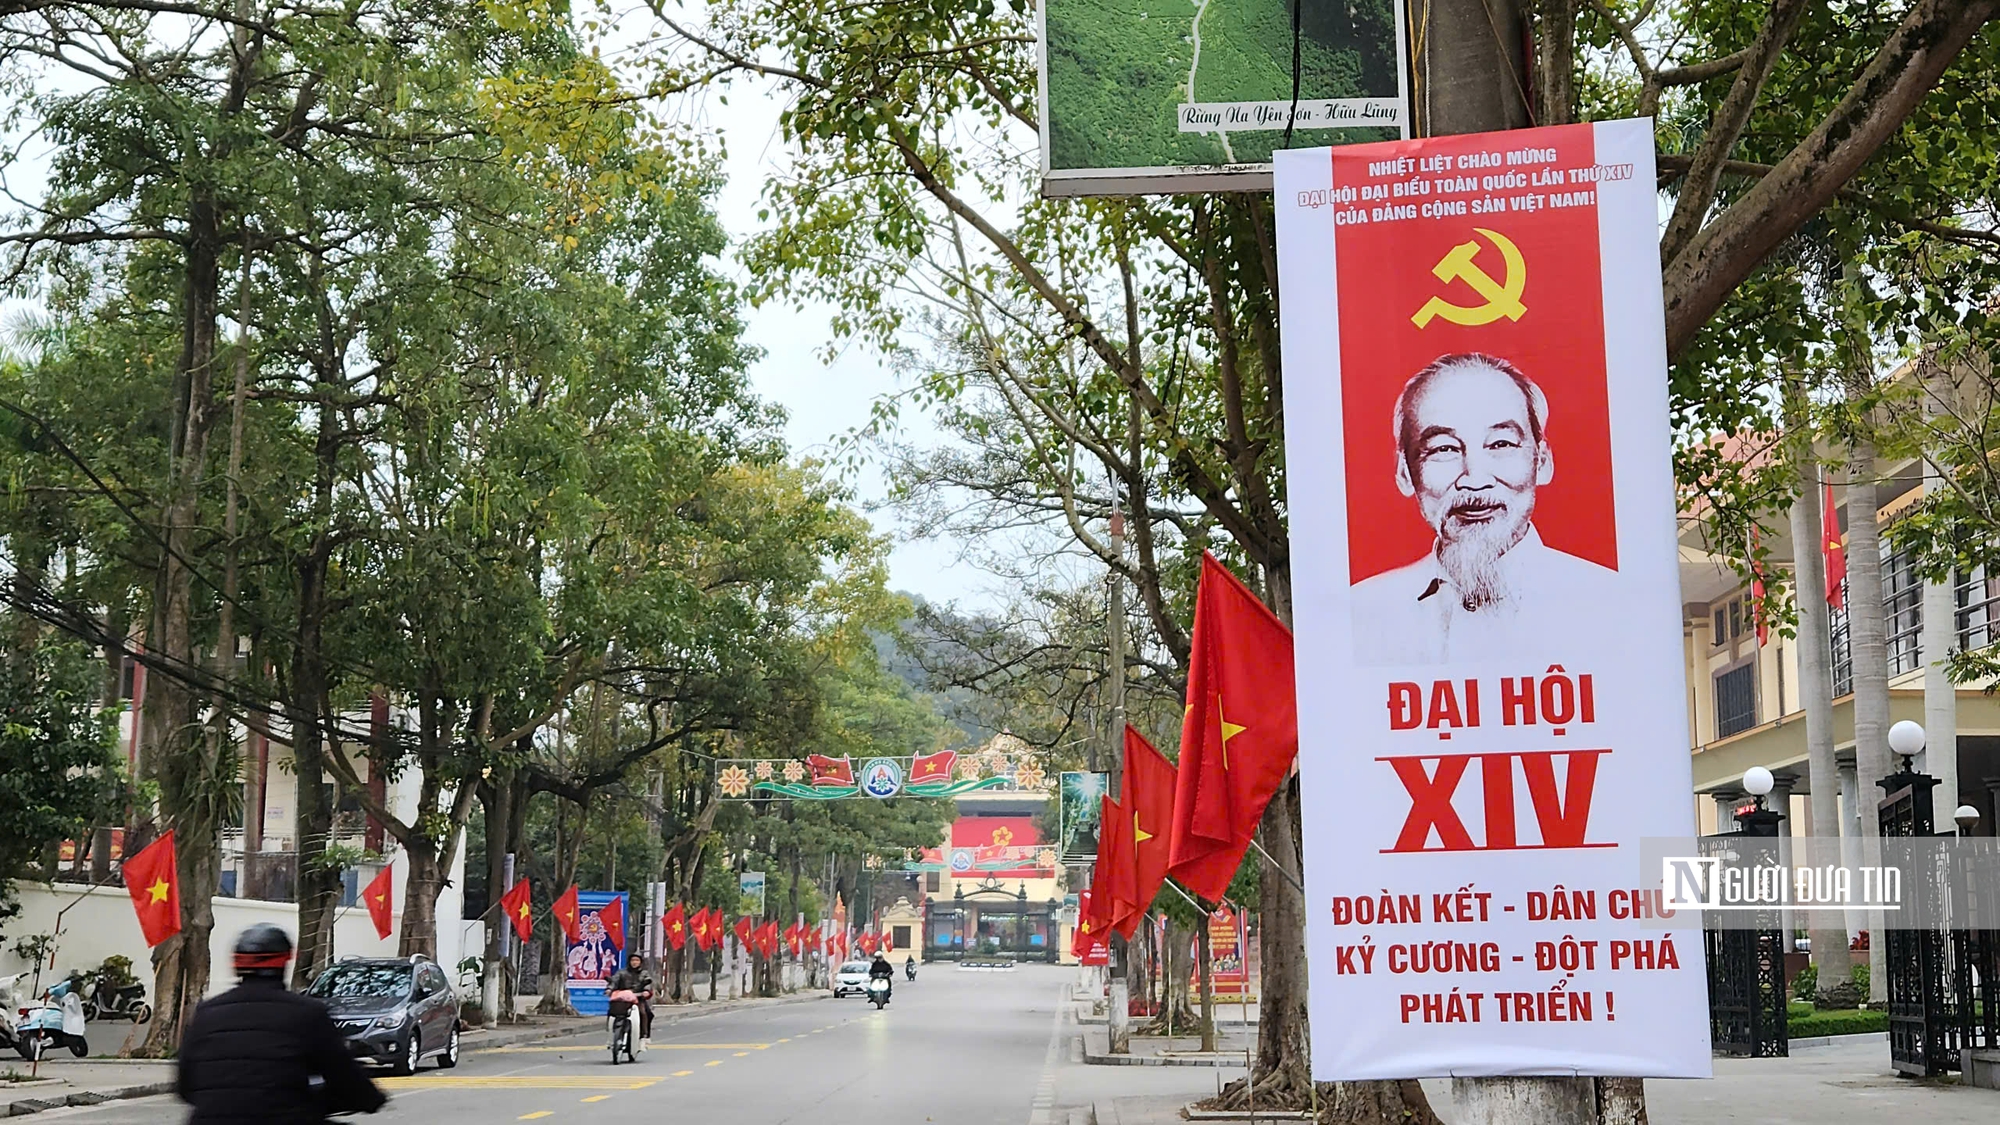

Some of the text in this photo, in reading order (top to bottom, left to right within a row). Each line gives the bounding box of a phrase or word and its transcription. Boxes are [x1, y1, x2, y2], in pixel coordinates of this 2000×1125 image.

[1182, 107, 1221, 127] Rừng
[1253, 105, 1283, 126] Yên
[1324, 102, 1356, 120] Hữu
[1361, 101, 1397, 122] Lũng
[1368, 147, 1557, 177] NHIỆT LIỆT CHÀO MỪNG
[1298, 163, 1633, 209] ĐẠI HỘI ĐẠI BIỂU TOÀN QUỐC LẦN THỨ XIV
[1335, 190, 1595, 226] CỦA ĐẢNG CỘNG SẢN VIỆT NAM!
[1386, 664, 1596, 741] ĐẠI HỘI
[1386, 751, 1602, 852] XIV
[1331, 888, 1422, 926] ĐOÀN
[1432, 883, 1493, 923] KẾT
[1526, 884, 1597, 922] DÂN
[1335, 934, 1376, 976] KỶ
[1387, 940, 1501, 974] CƯƠNG
[1534, 934, 1599, 978] ĐỘT
[1610, 933, 1680, 970] PHÁ
[1400, 986, 1485, 1024] PHÁT
[1494, 979, 1593, 1023] TRIỂN
